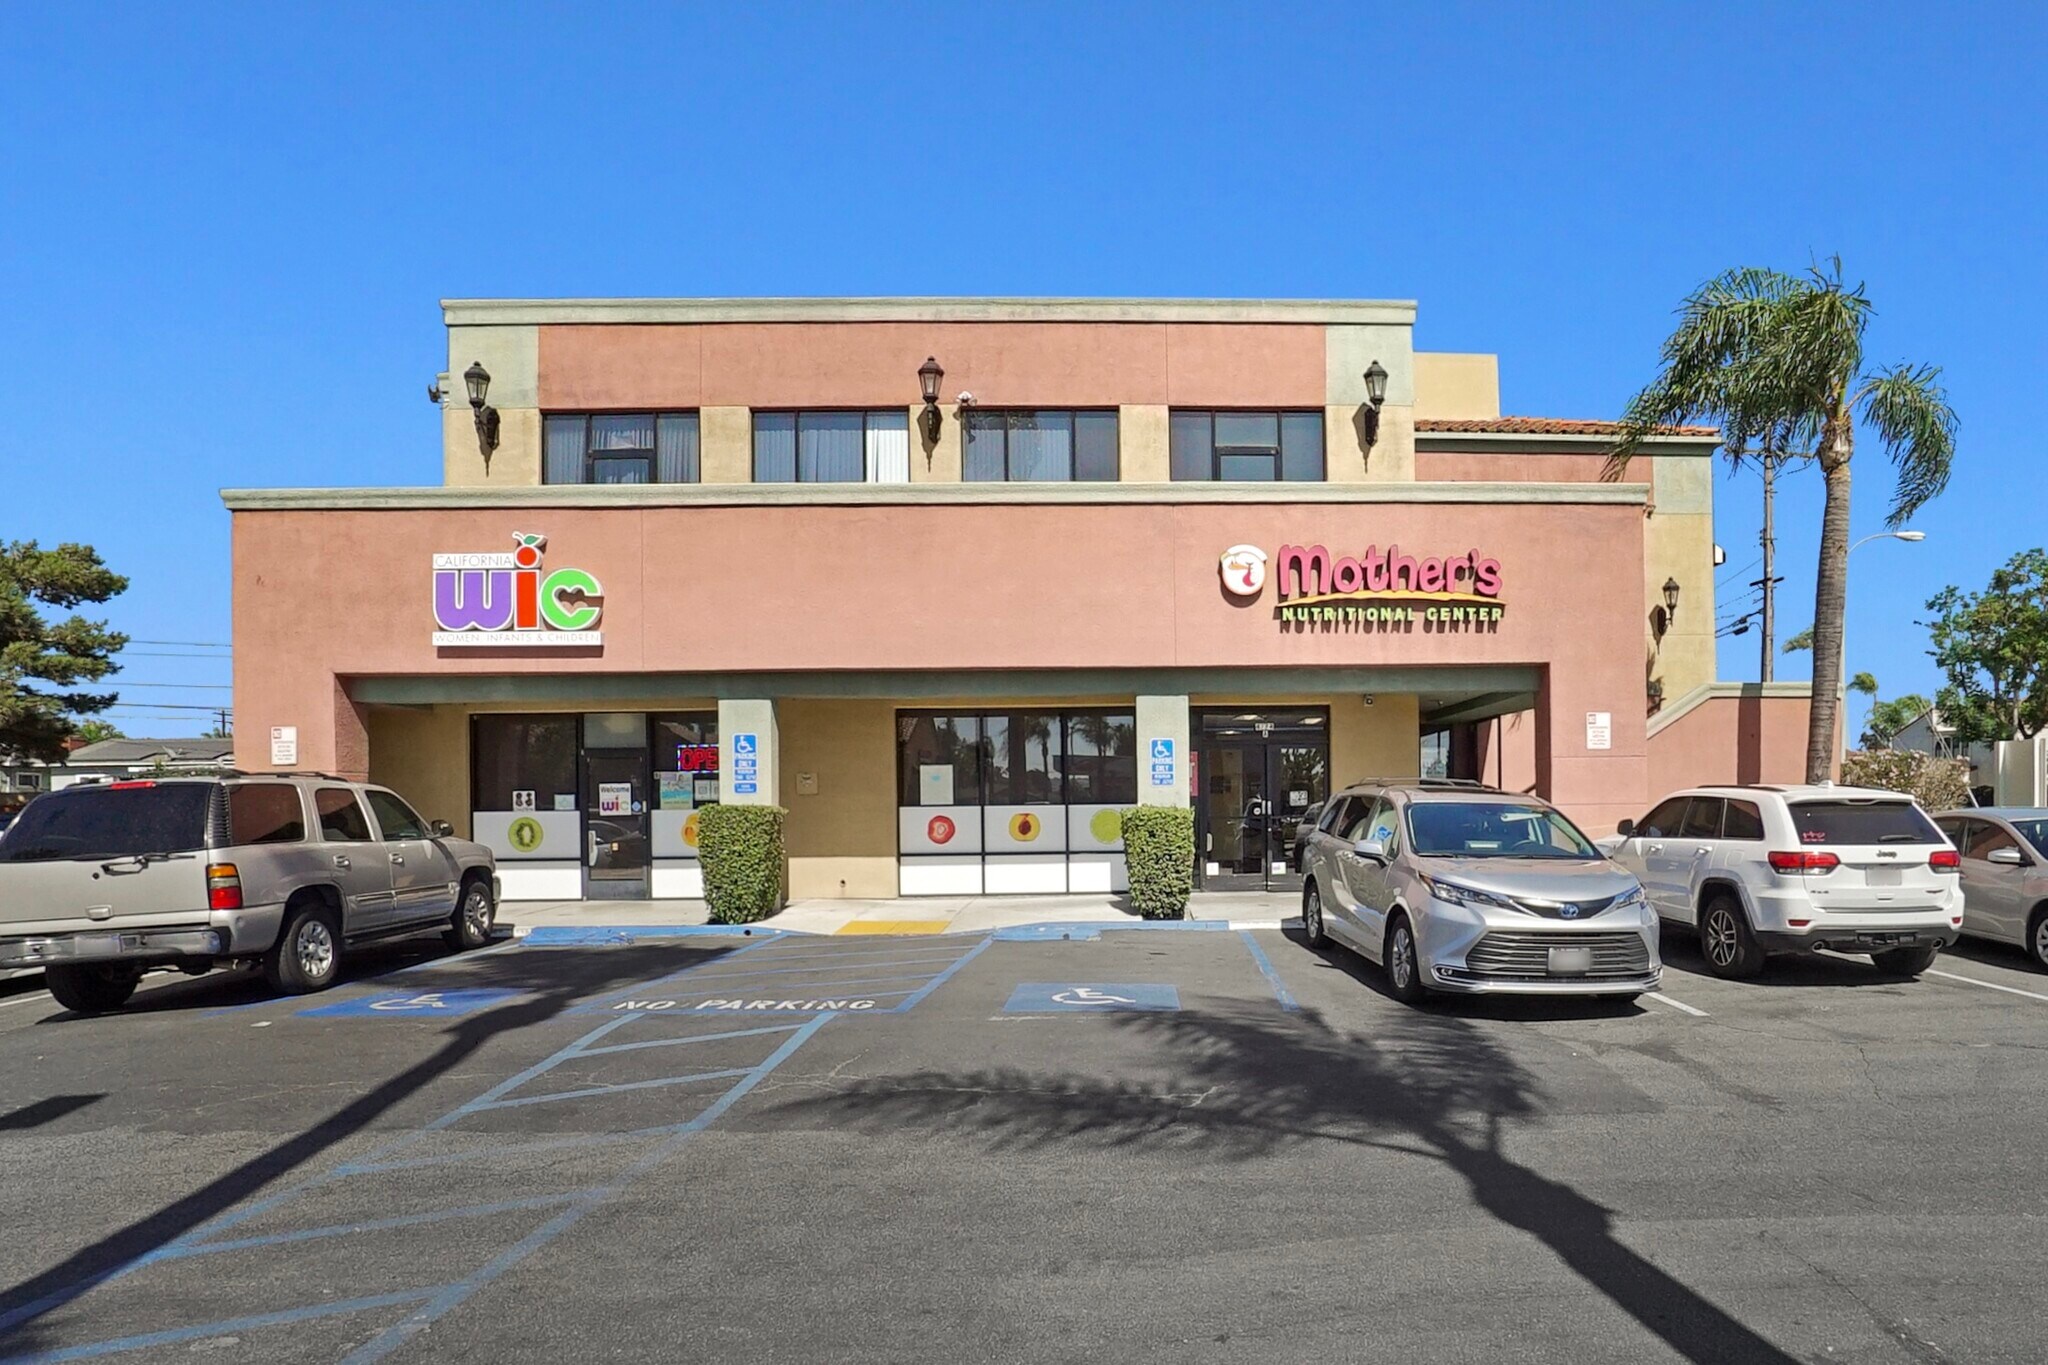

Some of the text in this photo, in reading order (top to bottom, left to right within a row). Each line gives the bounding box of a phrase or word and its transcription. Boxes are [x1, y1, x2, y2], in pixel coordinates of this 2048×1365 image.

[434, 554, 513, 568] CALIFORNIA
[1278, 544, 1503, 596] Mother's
[1281, 607, 1503, 622] NUTRITIONAL CENTER
[487, 632, 532, 643] INFANTS
[536, 632, 544, 643] &
[547, 632, 600, 643] CHILDREN
[681, 748, 719, 771] OPE
[1876, 850, 1897, 859] Jeep
[613, 999, 876, 1011] NO PARKING
